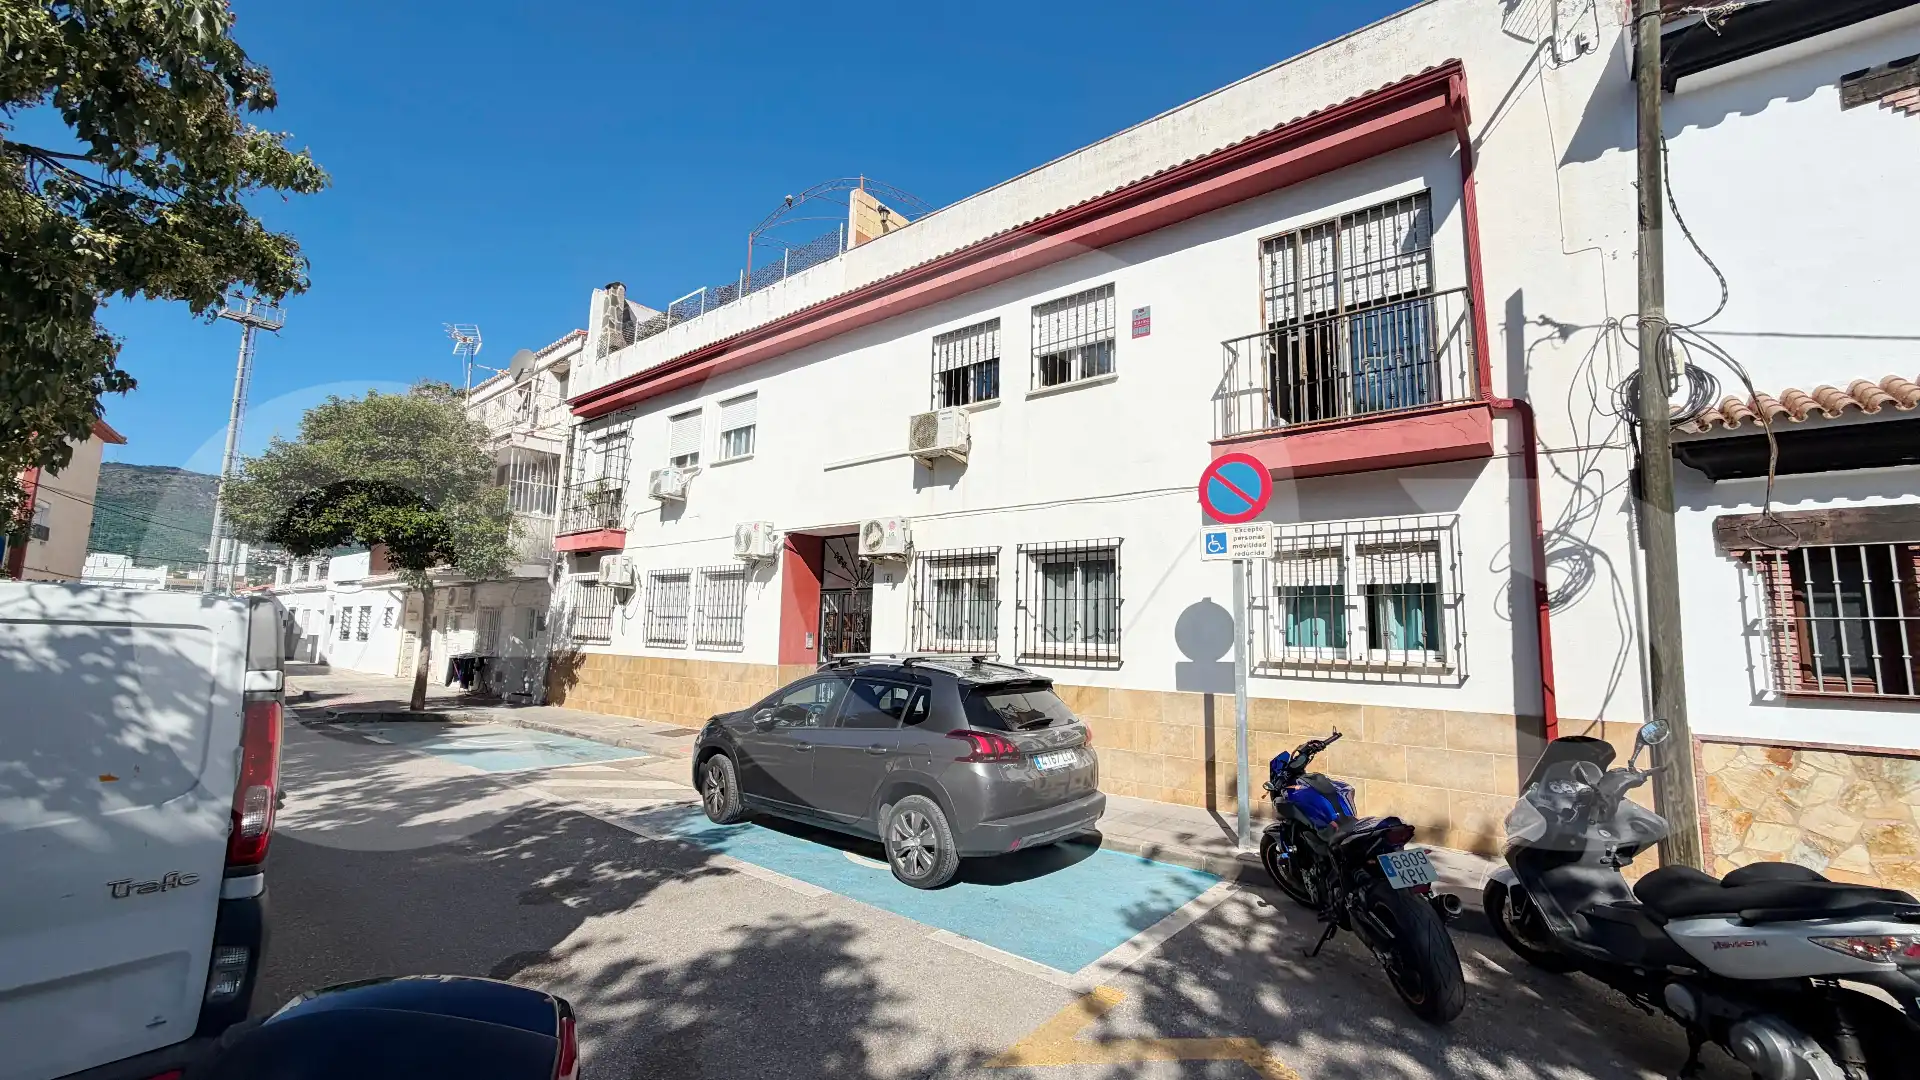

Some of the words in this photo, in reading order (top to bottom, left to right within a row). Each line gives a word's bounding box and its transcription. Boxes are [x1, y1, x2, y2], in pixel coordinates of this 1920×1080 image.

[1234, 526, 1263, 534] Excepto
[1233, 534, 1266, 542] personas
[1391, 851, 1428, 869] 6809
[1398, 867, 1429, 885] KPH
